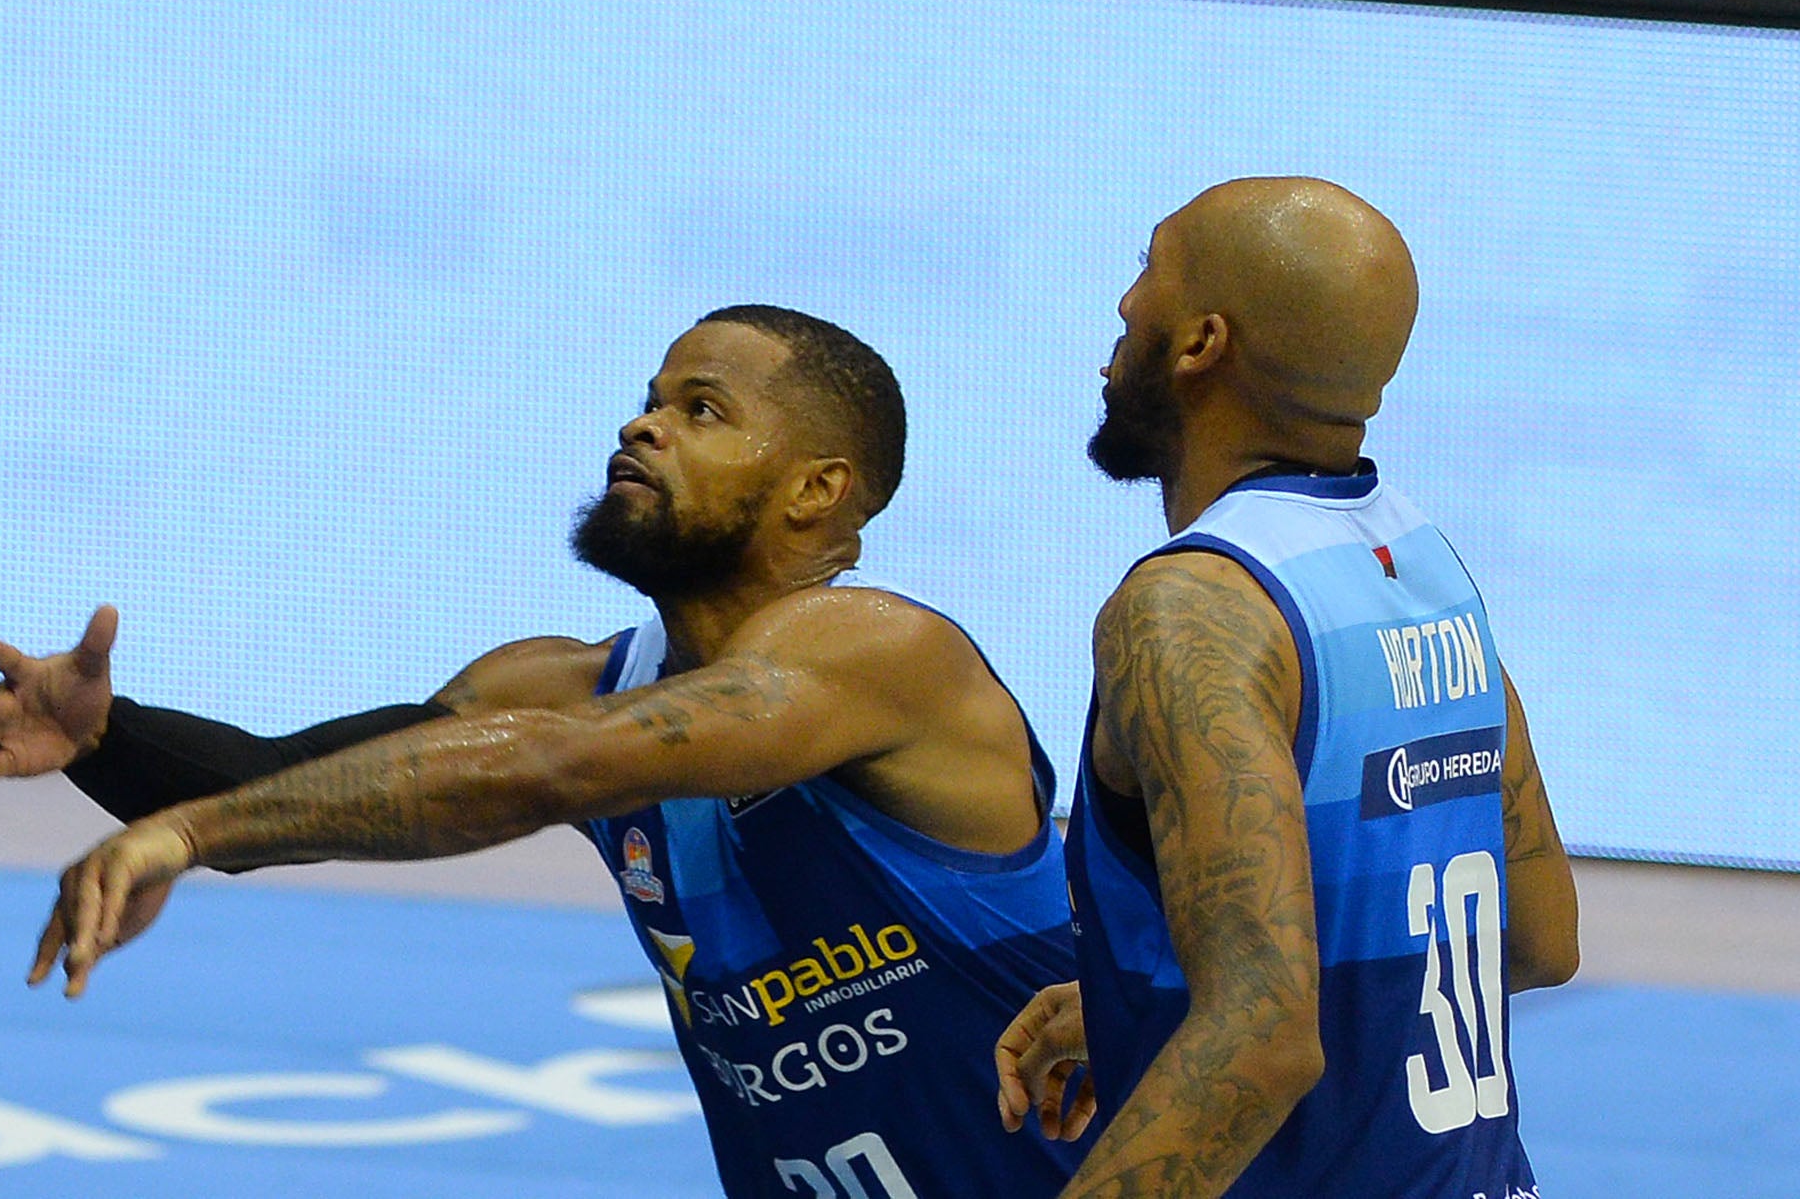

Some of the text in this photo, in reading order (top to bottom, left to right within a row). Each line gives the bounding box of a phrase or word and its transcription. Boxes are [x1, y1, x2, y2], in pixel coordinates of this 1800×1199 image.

[1376, 612, 1489, 710] HORTON
[1408, 749, 1502, 790] GRUPO HEREDA
[804, 957, 930, 1024] INMOBILIARIA
[1405, 850, 1509, 1134] 30
